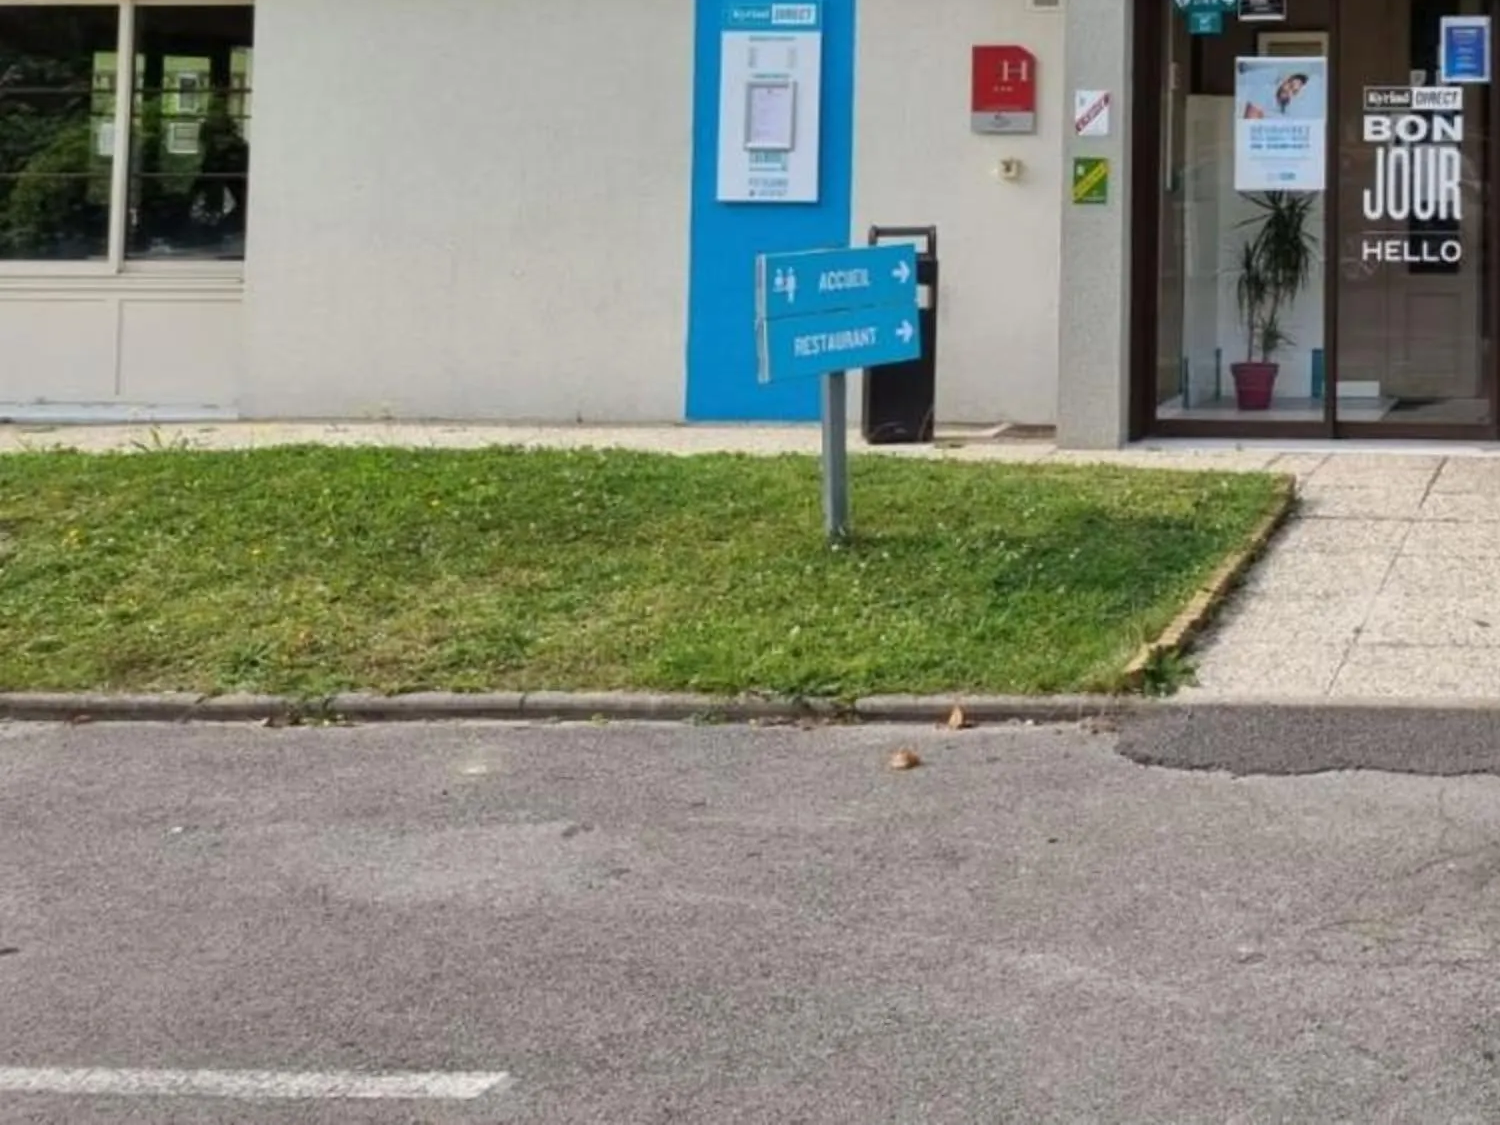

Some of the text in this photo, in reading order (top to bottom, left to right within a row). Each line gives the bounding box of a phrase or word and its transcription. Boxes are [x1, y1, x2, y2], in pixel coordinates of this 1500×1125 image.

[1003, 60, 1027, 82] H
[1368, 90, 1459, 106] Kyriad DIRECT
[1363, 115, 1463, 142] BON
[1363, 146, 1463, 220] JOUR
[1362, 240, 1462, 262] HELLO
[818, 268, 870, 293] ACCUEIL
[793, 327, 877, 357] RESTAURANT
